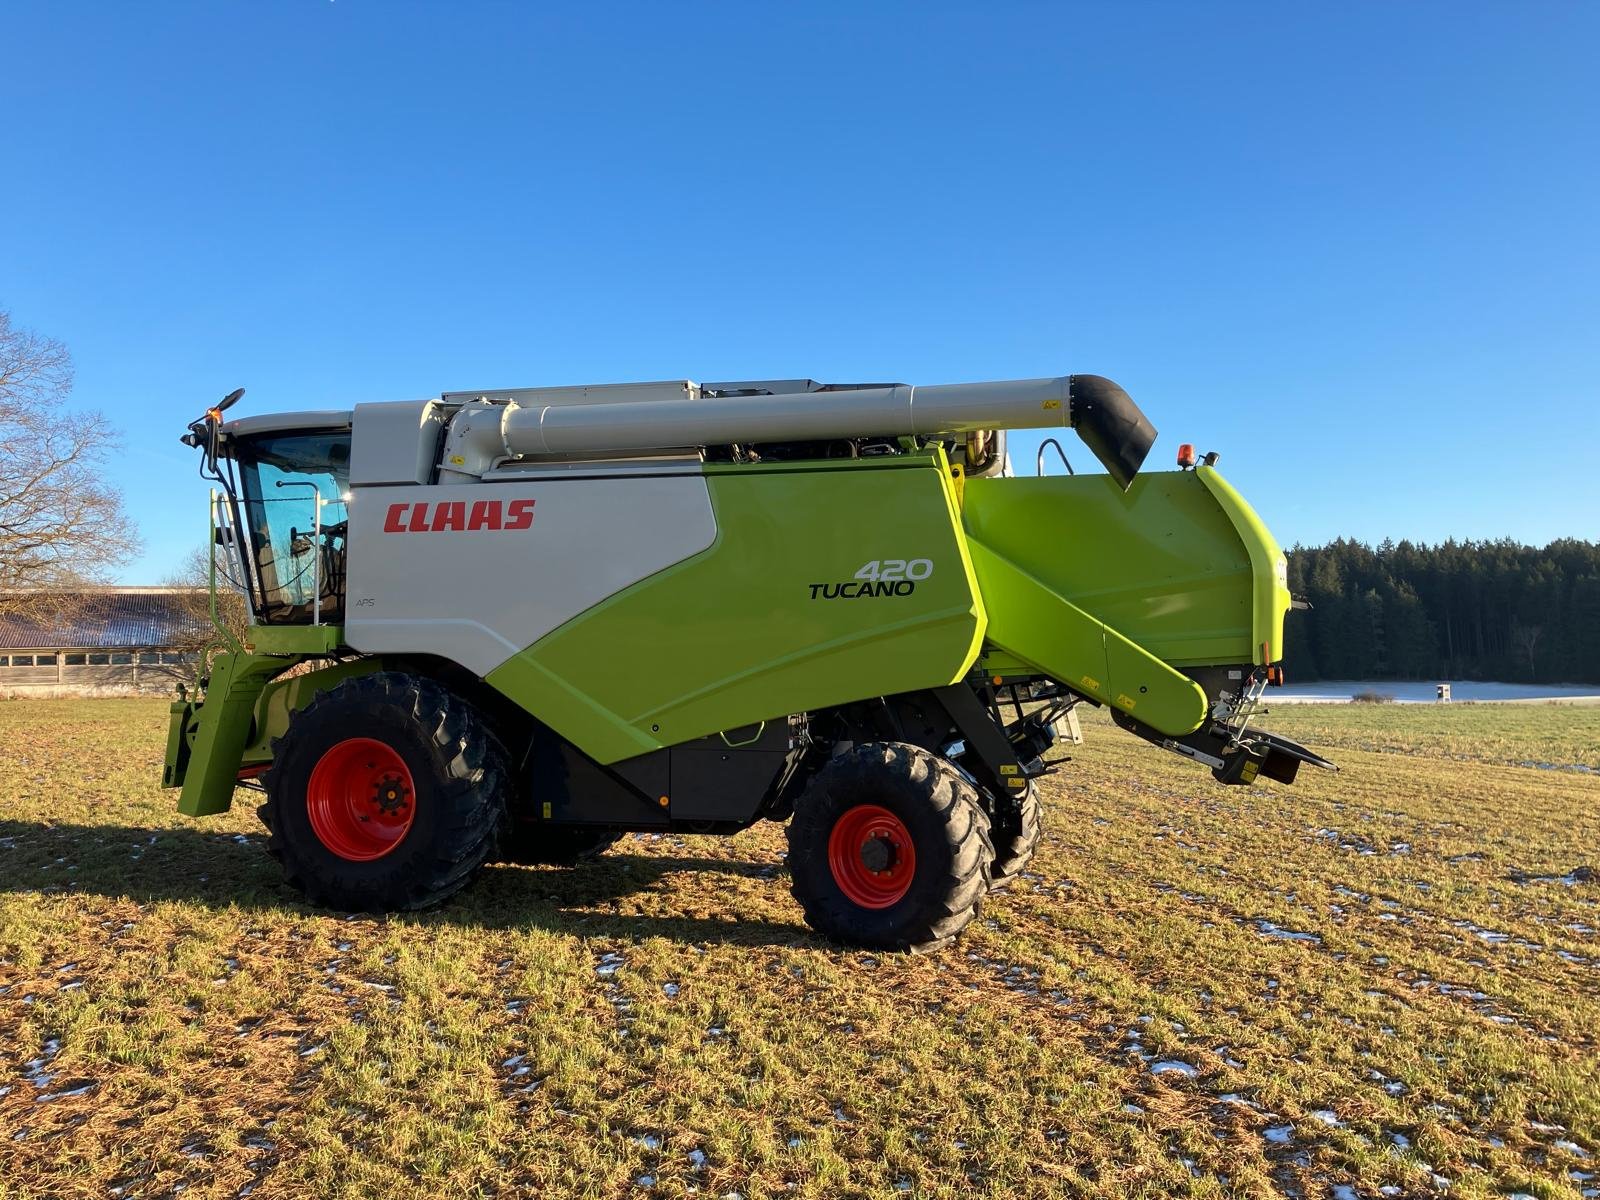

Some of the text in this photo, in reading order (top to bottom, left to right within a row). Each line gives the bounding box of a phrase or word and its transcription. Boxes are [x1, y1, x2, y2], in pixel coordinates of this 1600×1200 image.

[384, 500, 536, 532] CLAAS
[854, 558, 934, 582] 420
[809, 581, 915, 600] TUCANO
[356, 598, 375, 607] APS
